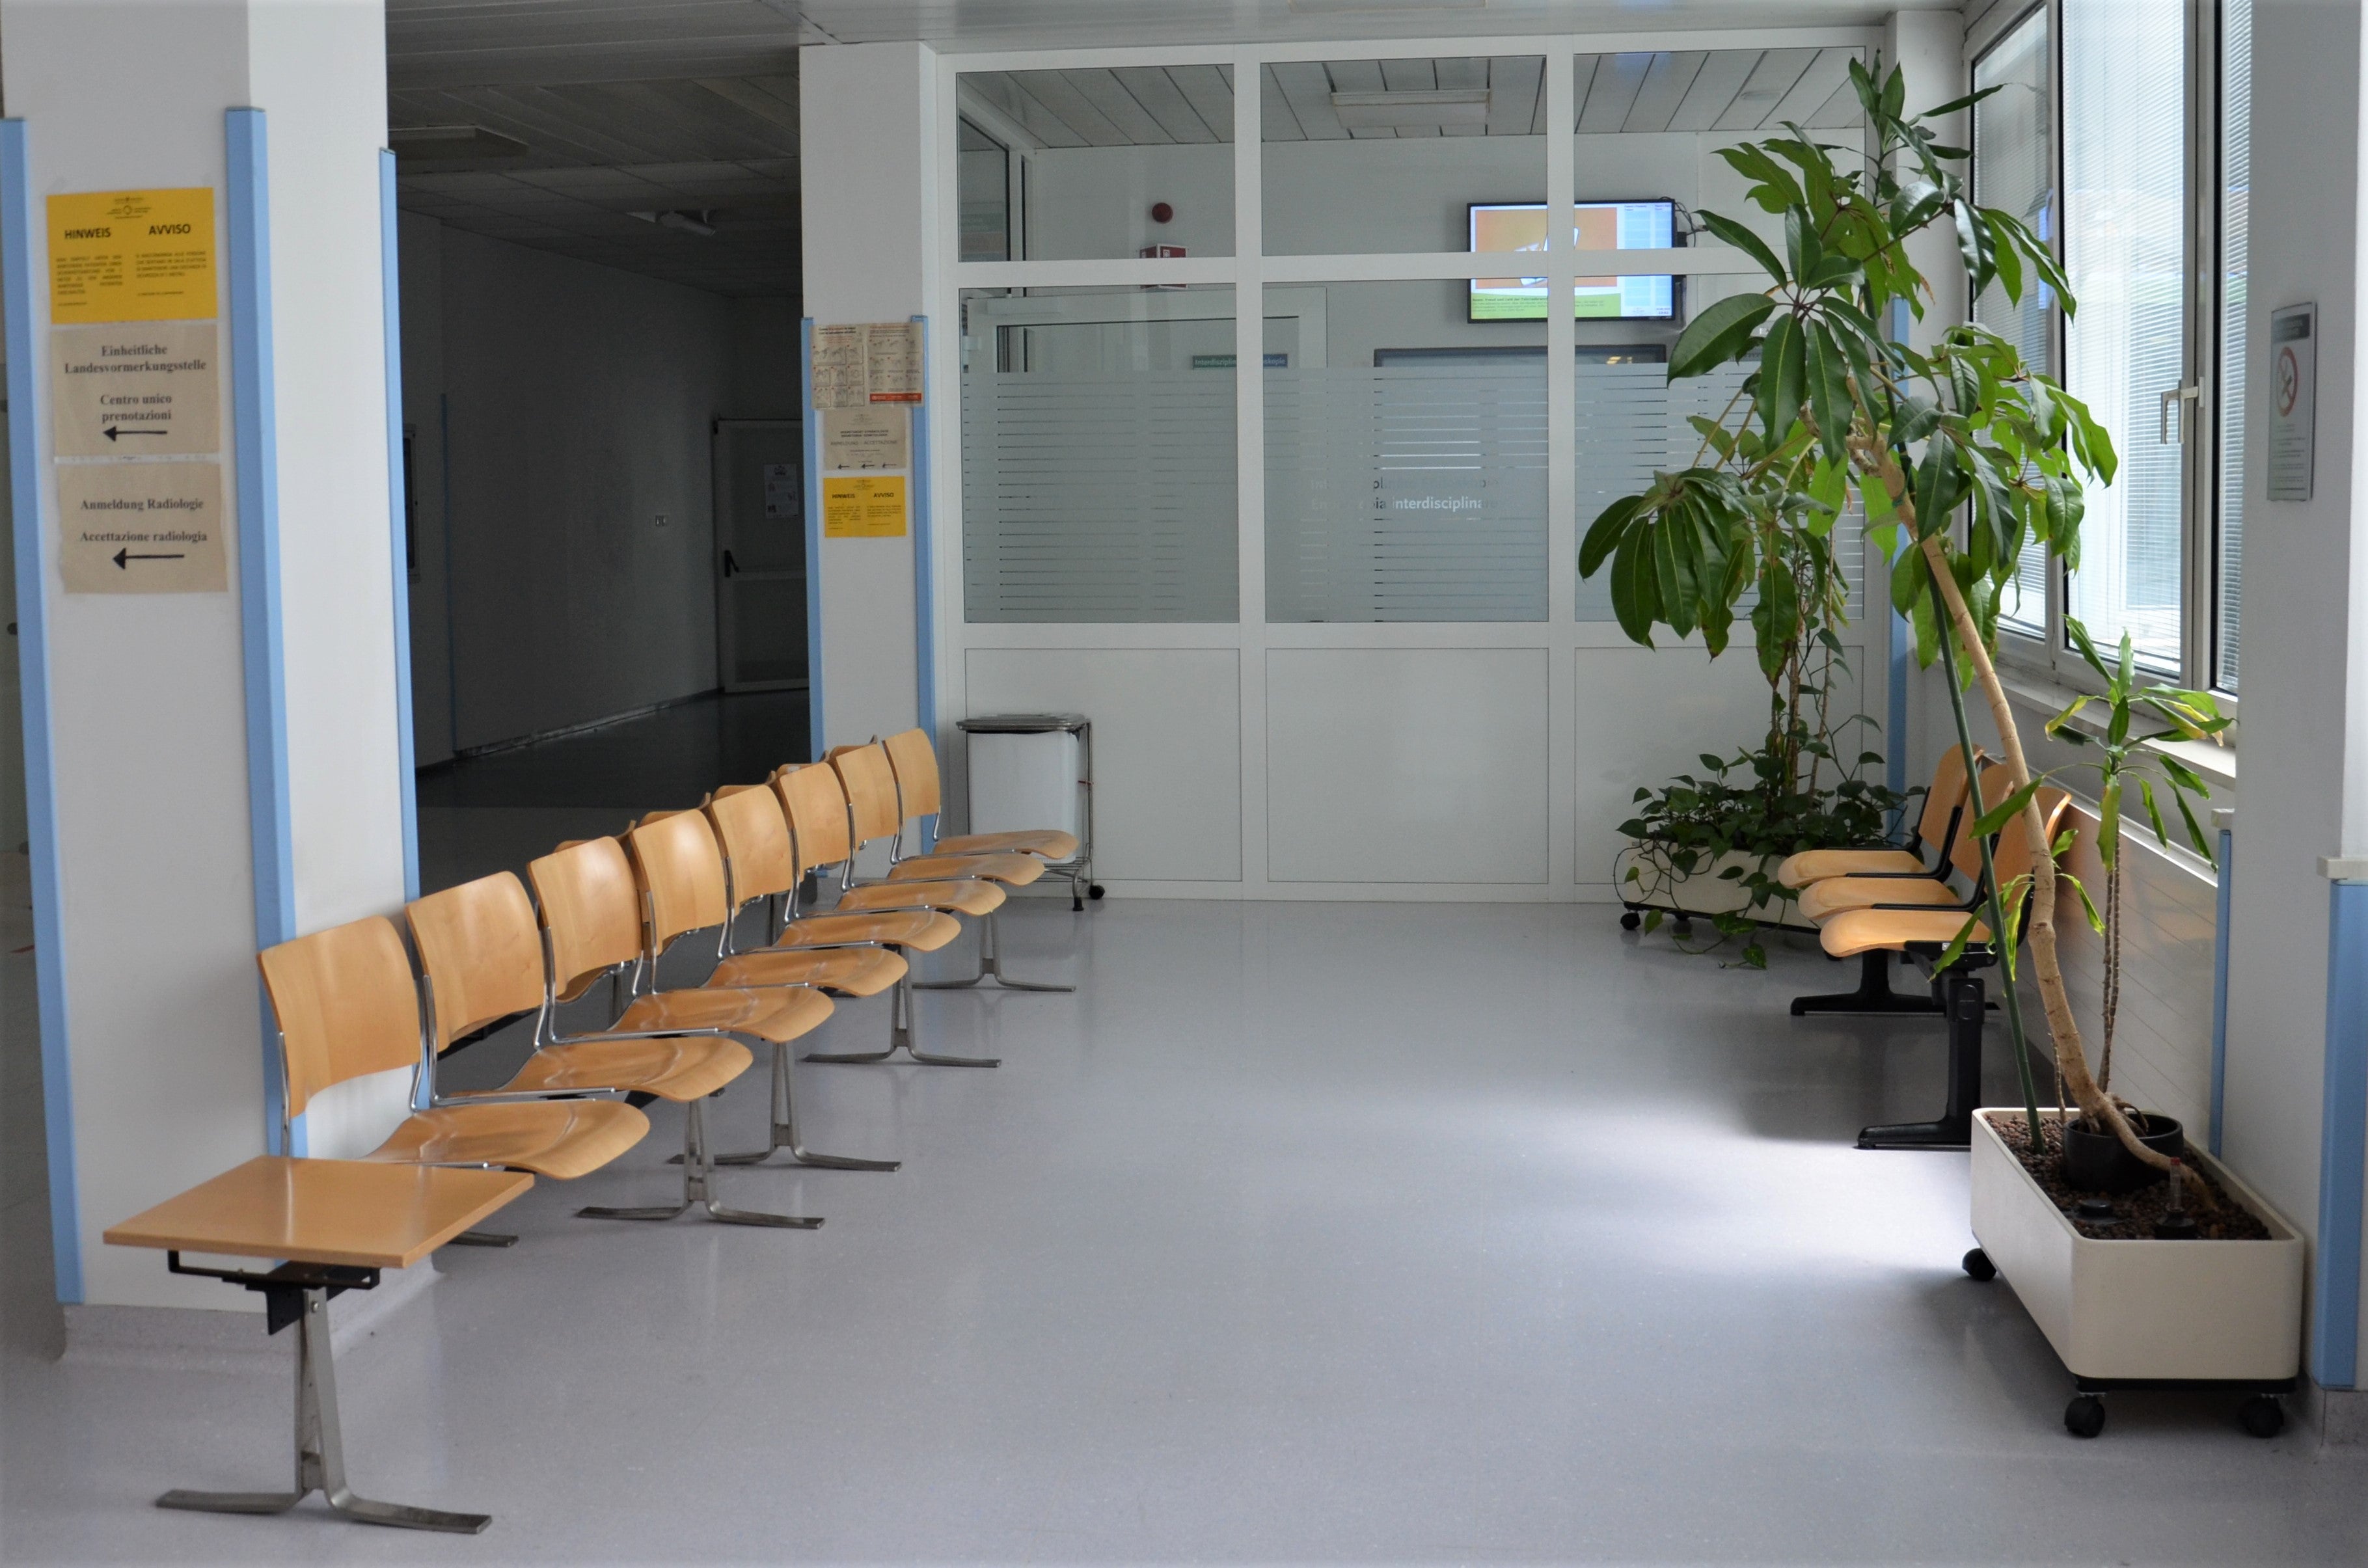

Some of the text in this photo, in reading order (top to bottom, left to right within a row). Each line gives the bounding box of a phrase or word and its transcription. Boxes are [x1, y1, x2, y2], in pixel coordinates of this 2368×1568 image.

[64, 228, 111, 240] HINWEIS
[148, 223, 191, 236] AVVISO
[101, 344, 168, 357] Einheitliche
[64, 360, 207, 374] Landesvormerkungsstelle
[100, 394, 172, 405] Centro unico
[102, 411, 172, 424] prenotazioni
[80, 498, 204, 512] Anmeldung Radiologie
[1392, 496, 1482, 513] interdisciplina
[80, 531, 208, 544] Accettazione radiologia
